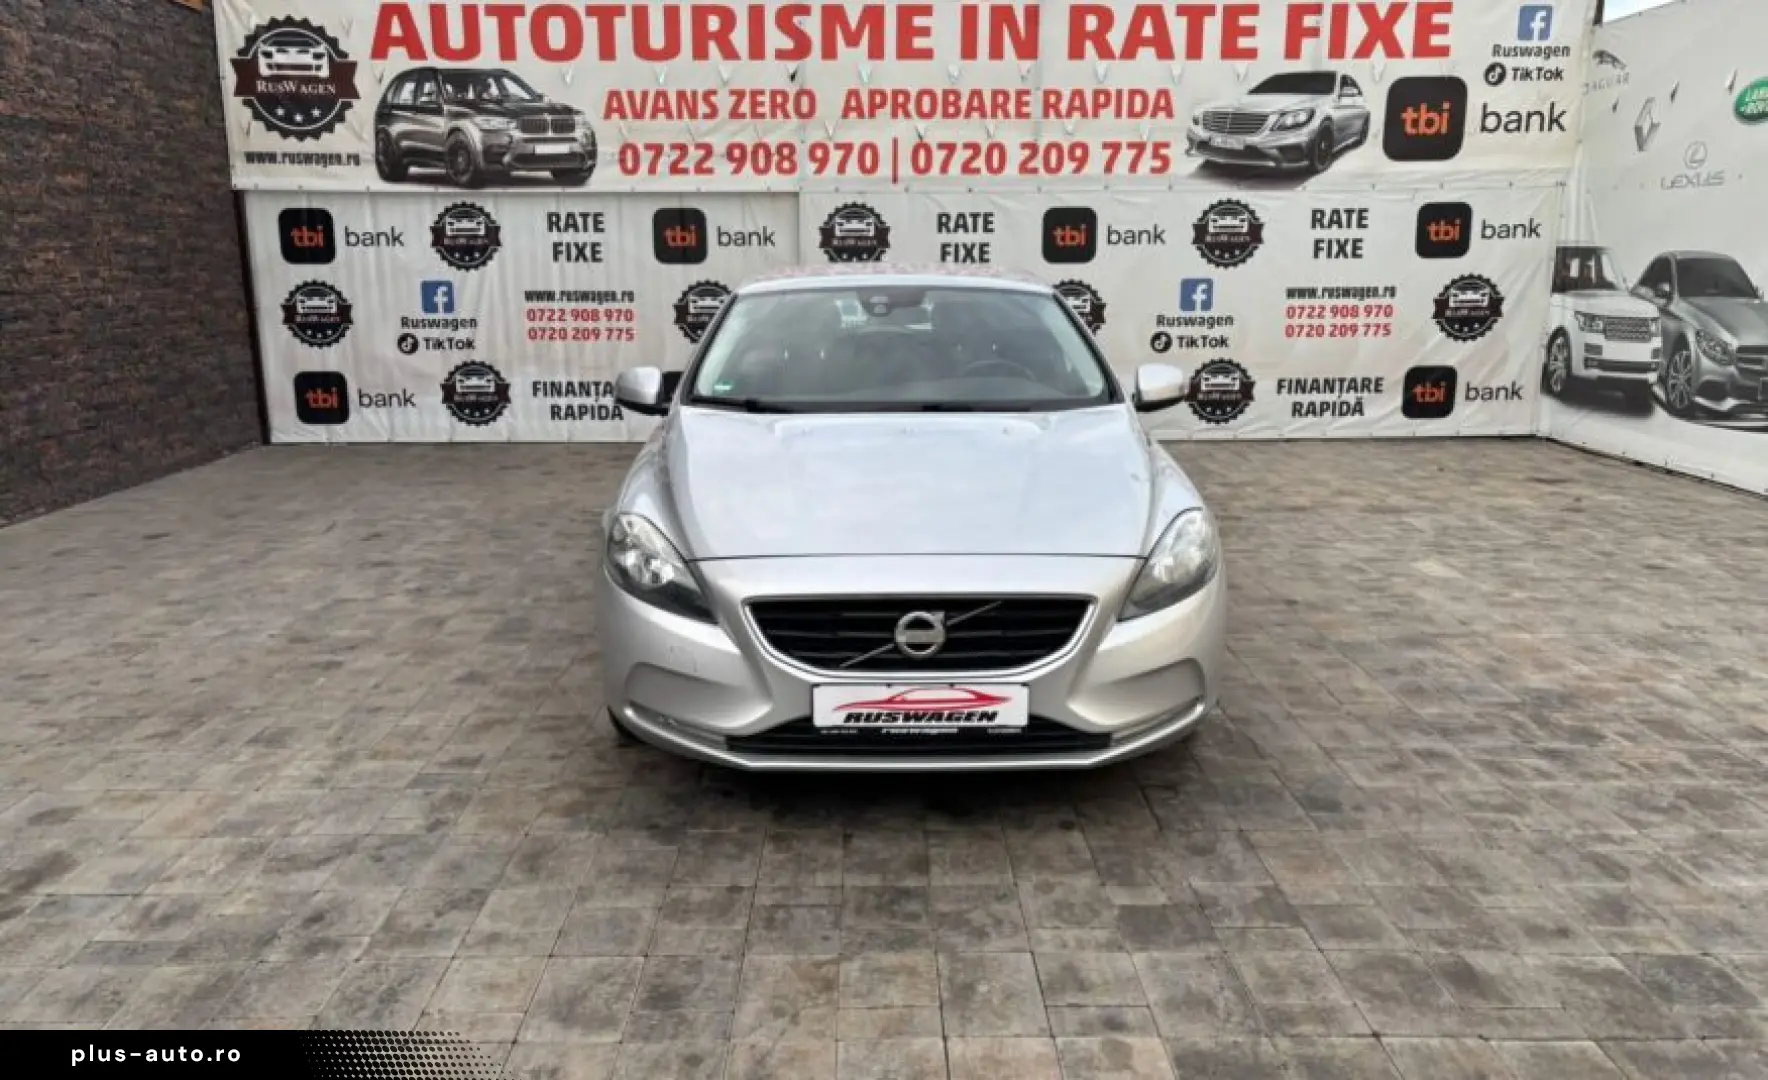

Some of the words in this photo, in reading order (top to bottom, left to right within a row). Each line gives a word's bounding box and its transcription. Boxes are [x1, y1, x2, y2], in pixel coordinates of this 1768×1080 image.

[371, 3, 934, 62] AUTOTURISME
[959, 3, 1040, 62] IN
[1067, 3, 1258, 61] RATE
[1283, 2, 1453, 59] FIXE
[1492, 43, 1571, 59] Ruswagen
[1511, 65, 1564, 83] TikTok
[603, 88, 720, 121] AVANS
[728, 88, 818, 121] ZERO
[841, 88, 1033, 121] APROBARE
[1042, 87, 1175, 121] RAPIDA
[1401, 102, 1452, 136] tbi
[1480, 102, 1567, 133] bank
[244, 150, 361, 169] www.ruswagen.ro
[618, 141, 716, 176] 0722
[726, 141, 799, 176] 908
[808, 141, 880, 176] 970
[910, 141, 1007, 176] 0720
[1017, 141, 1091, 176] 209
[1101, 140, 1171, 175] 775
[1660, 170, 1726, 191] LEXUS
[546, 212, 605, 233] RATE
[937, 211, 995, 233] RATE
[1311, 207, 1369, 229] RATE
[290, 226, 325, 247] tbi
[345, 226, 404, 248] bank
[663, 225, 696, 247] tbi
[716, 225, 776, 247] bank
[1053, 226, 1088, 247] tbi
[1107, 225, 1166, 246] bank
[1427, 219, 1461, 241] tbi
[1480, 218, 1541, 240] bank
[552, 242, 604, 263] FIXE
[940, 242, 991, 264] FIXE
[1313, 238, 1364, 259] FIXE
[527, 308, 567, 321] 0722
[570, 308, 600, 321] 908
[604, 308, 634, 321] 970
[1155, 314, 1234, 330] Ruswagen
[1287, 305, 1325, 320] 0722
[1329, 304, 1359, 319] 908
[1363, 304, 1394, 318] 970
[400, 316, 478, 333] Ruswagen
[528, 327, 568, 340] 0720
[572, 327, 600, 340] 209
[604, 327, 635, 340] 775
[1285, 324, 1324, 338] 0720
[1329, 323, 1358, 337] 209
[1363, 323, 1392, 337] 775
[423, 337, 476, 351] TikTok
[1177, 335, 1229, 350] TikTok
[306, 389, 339, 409] tbi
[358, 388, 416, 409] bank
[1412, 380, 1446, 402] tbi
[1465, 381, 1523, 402] bank
